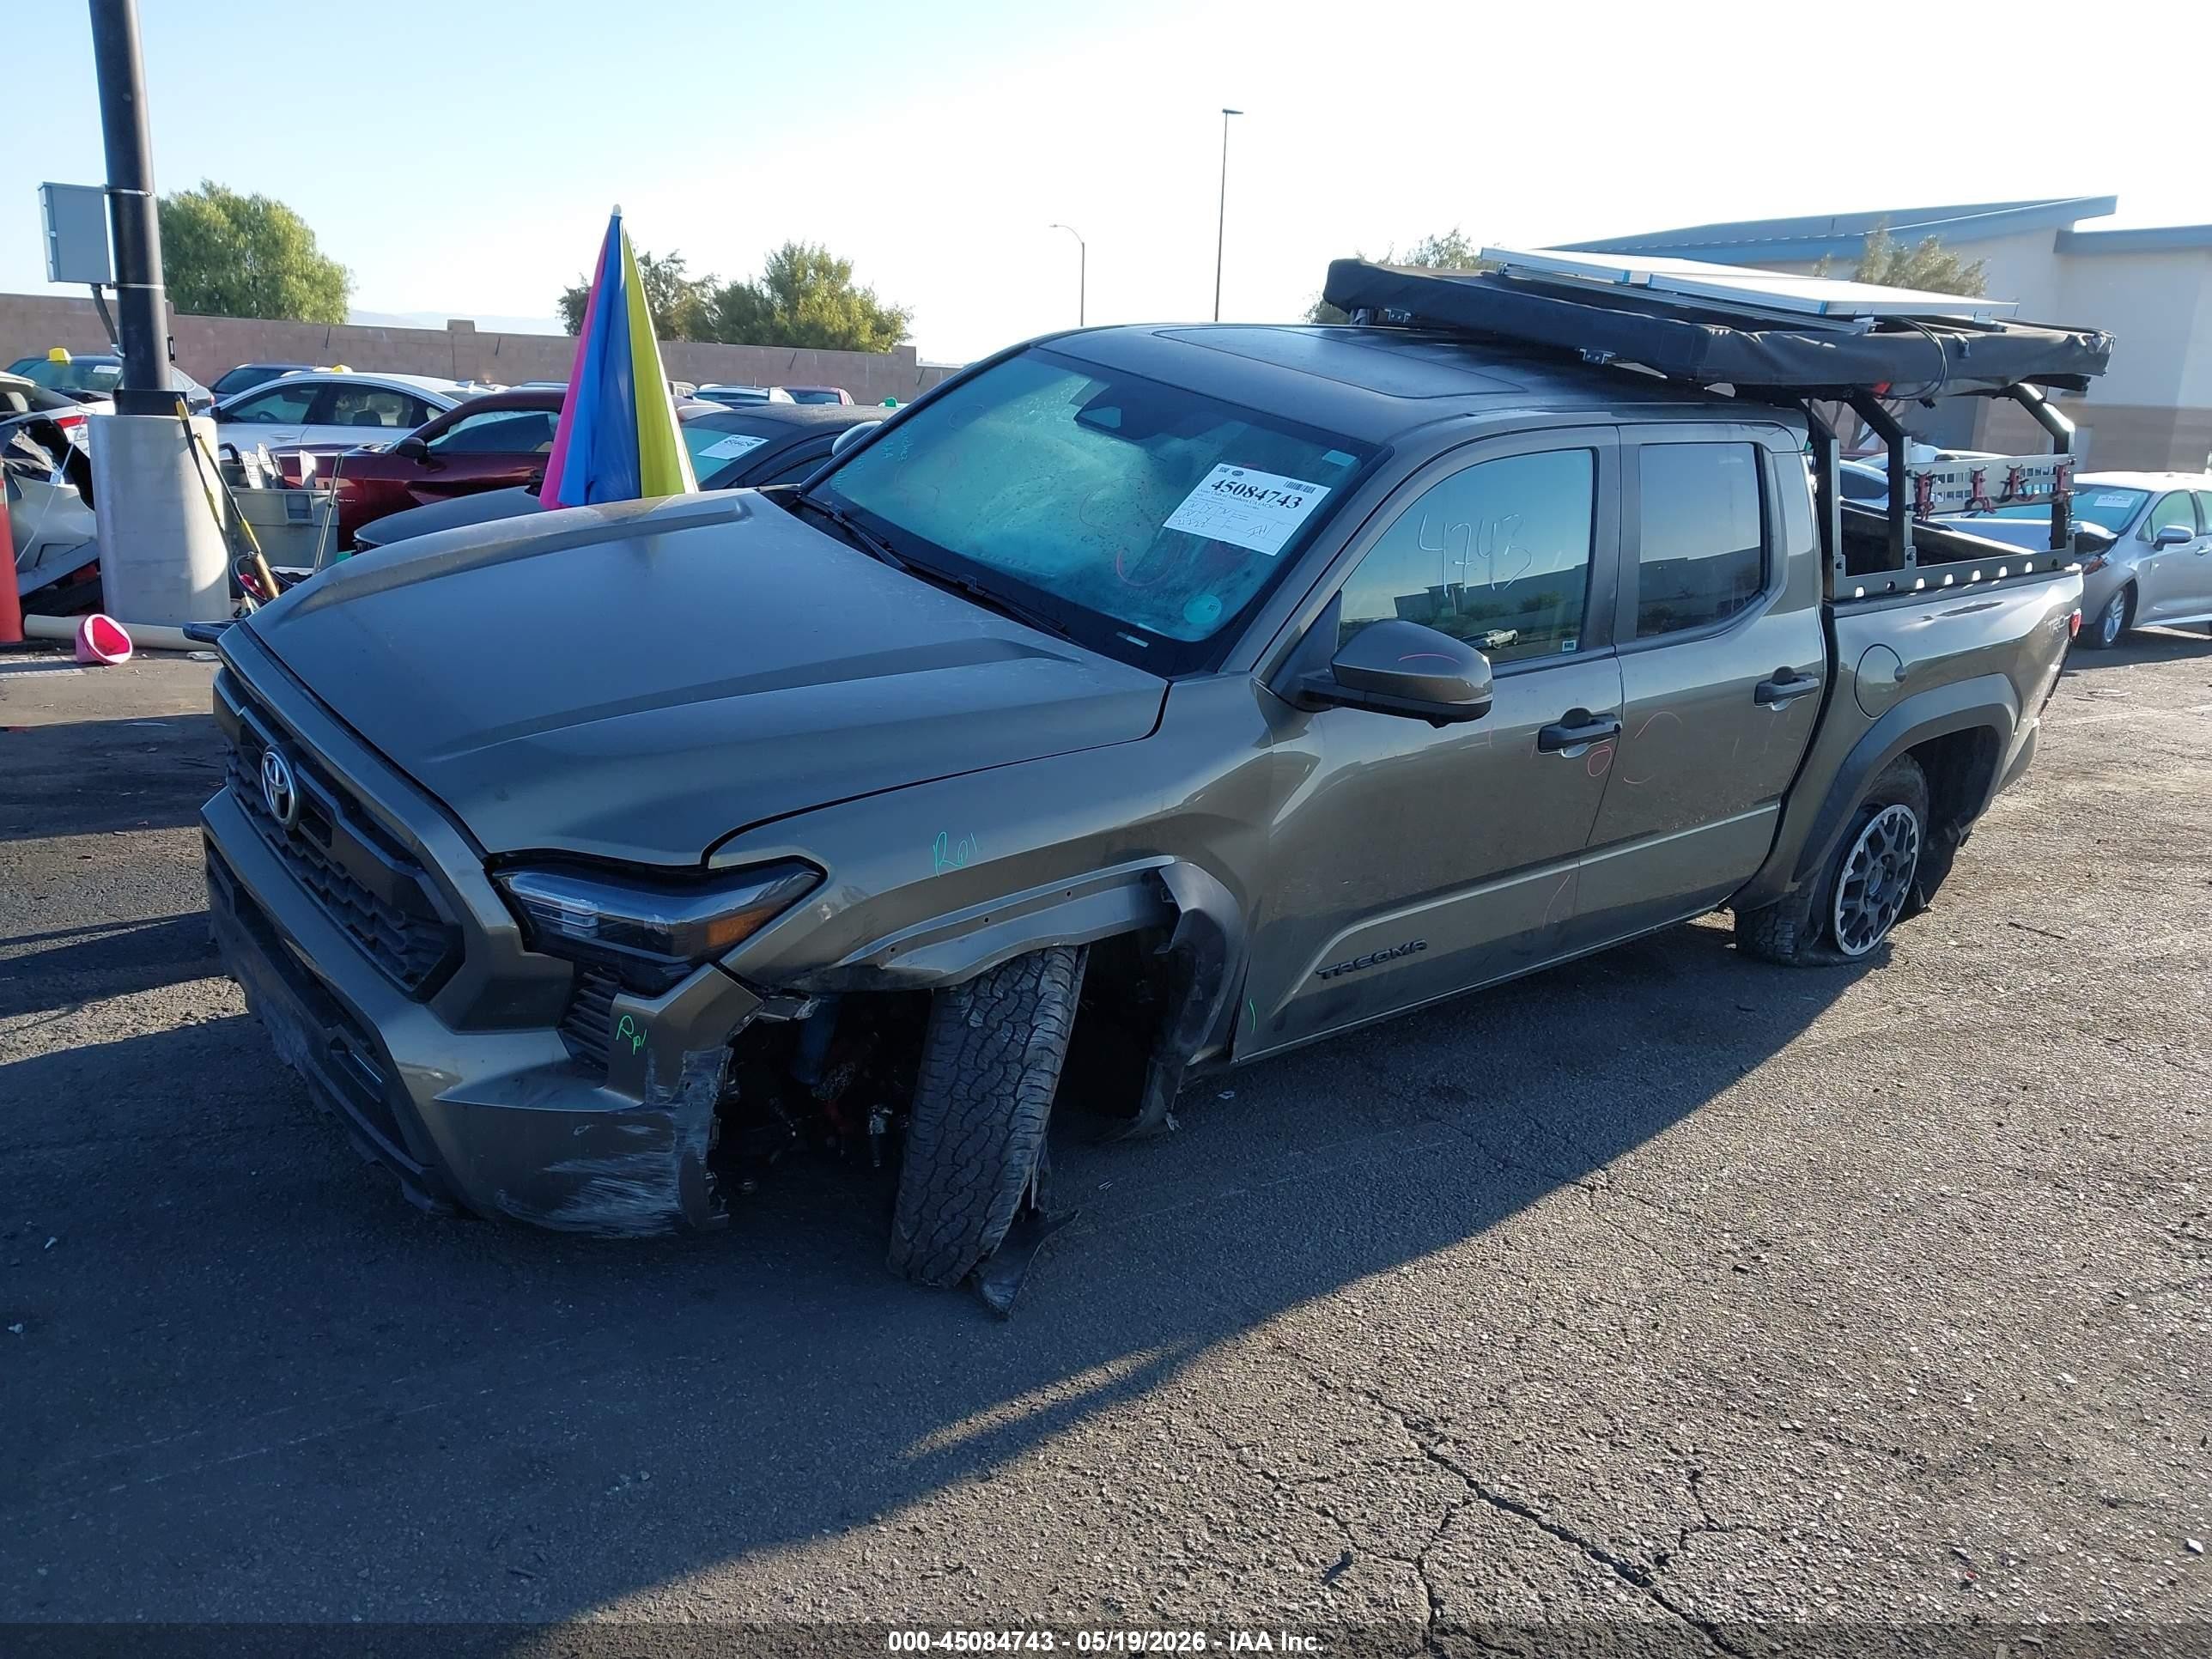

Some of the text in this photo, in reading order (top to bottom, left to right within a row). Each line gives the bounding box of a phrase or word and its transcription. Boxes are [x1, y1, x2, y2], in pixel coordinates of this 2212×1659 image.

[1211, 478, 1304, 510] 45084743
[1417, 513, 1533, 599] 4743
[1316, 939, 1429, 980] TACOMA
